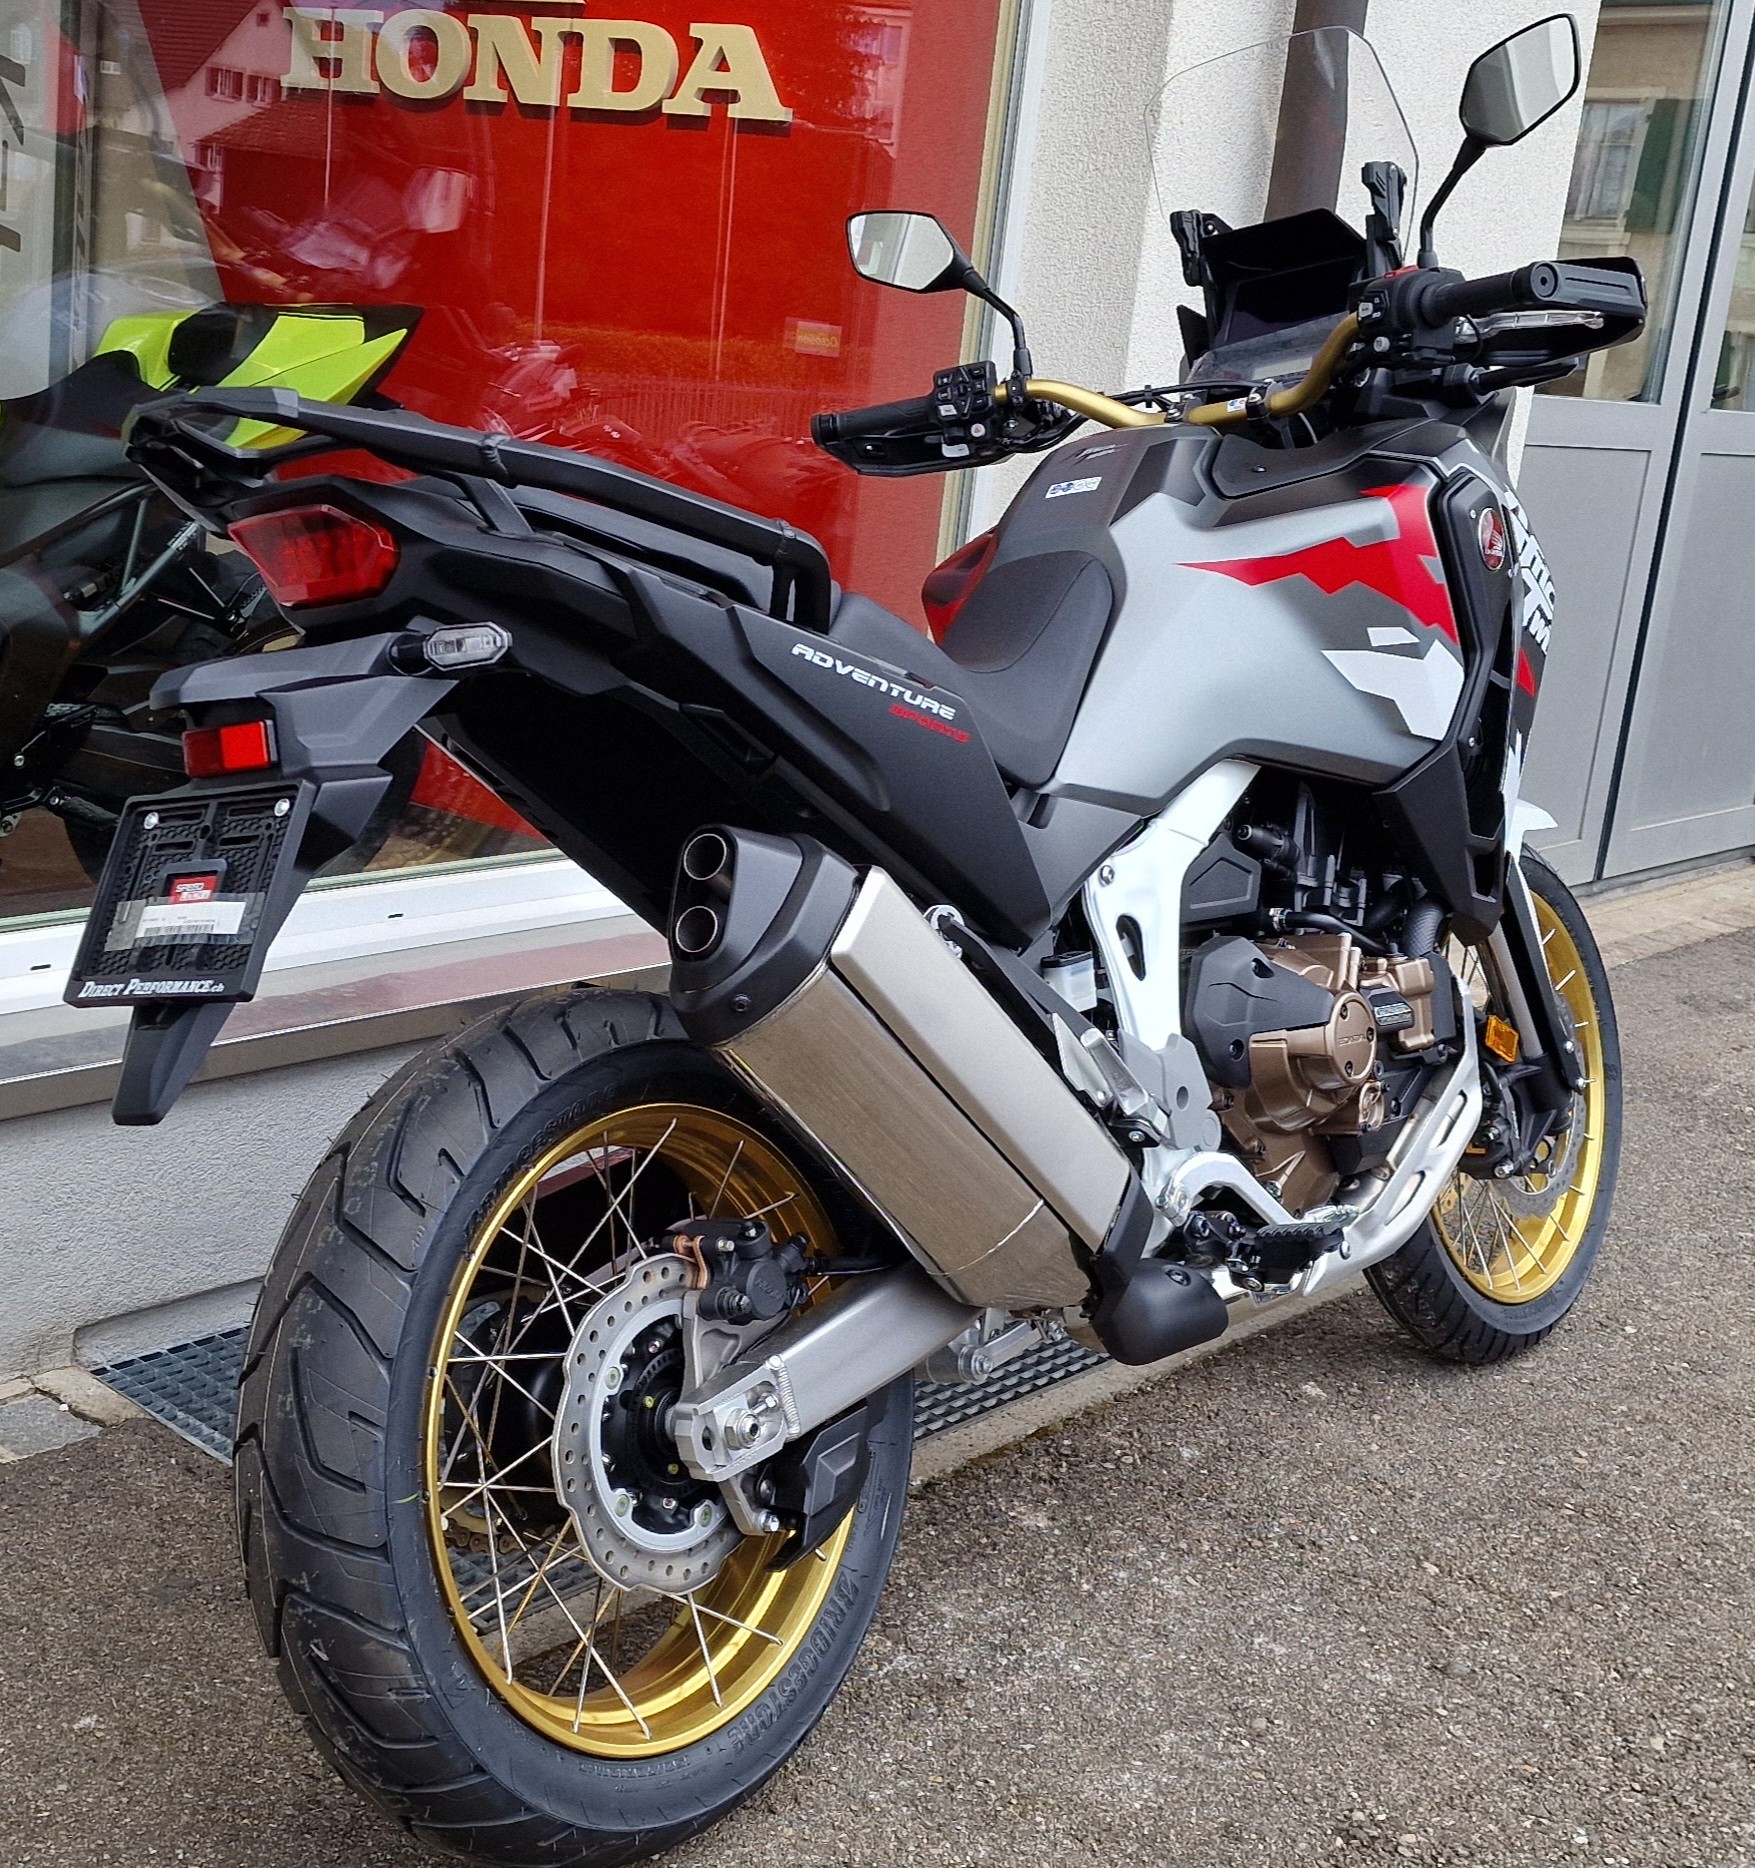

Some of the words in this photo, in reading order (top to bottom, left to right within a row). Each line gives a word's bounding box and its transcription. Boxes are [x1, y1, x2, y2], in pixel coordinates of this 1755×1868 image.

[280, 6, 795, 123] HONDA
[791, 643, 957, 721] ADVENTURE
[727, 1571, 860, 1751] BRIDGESTONE
